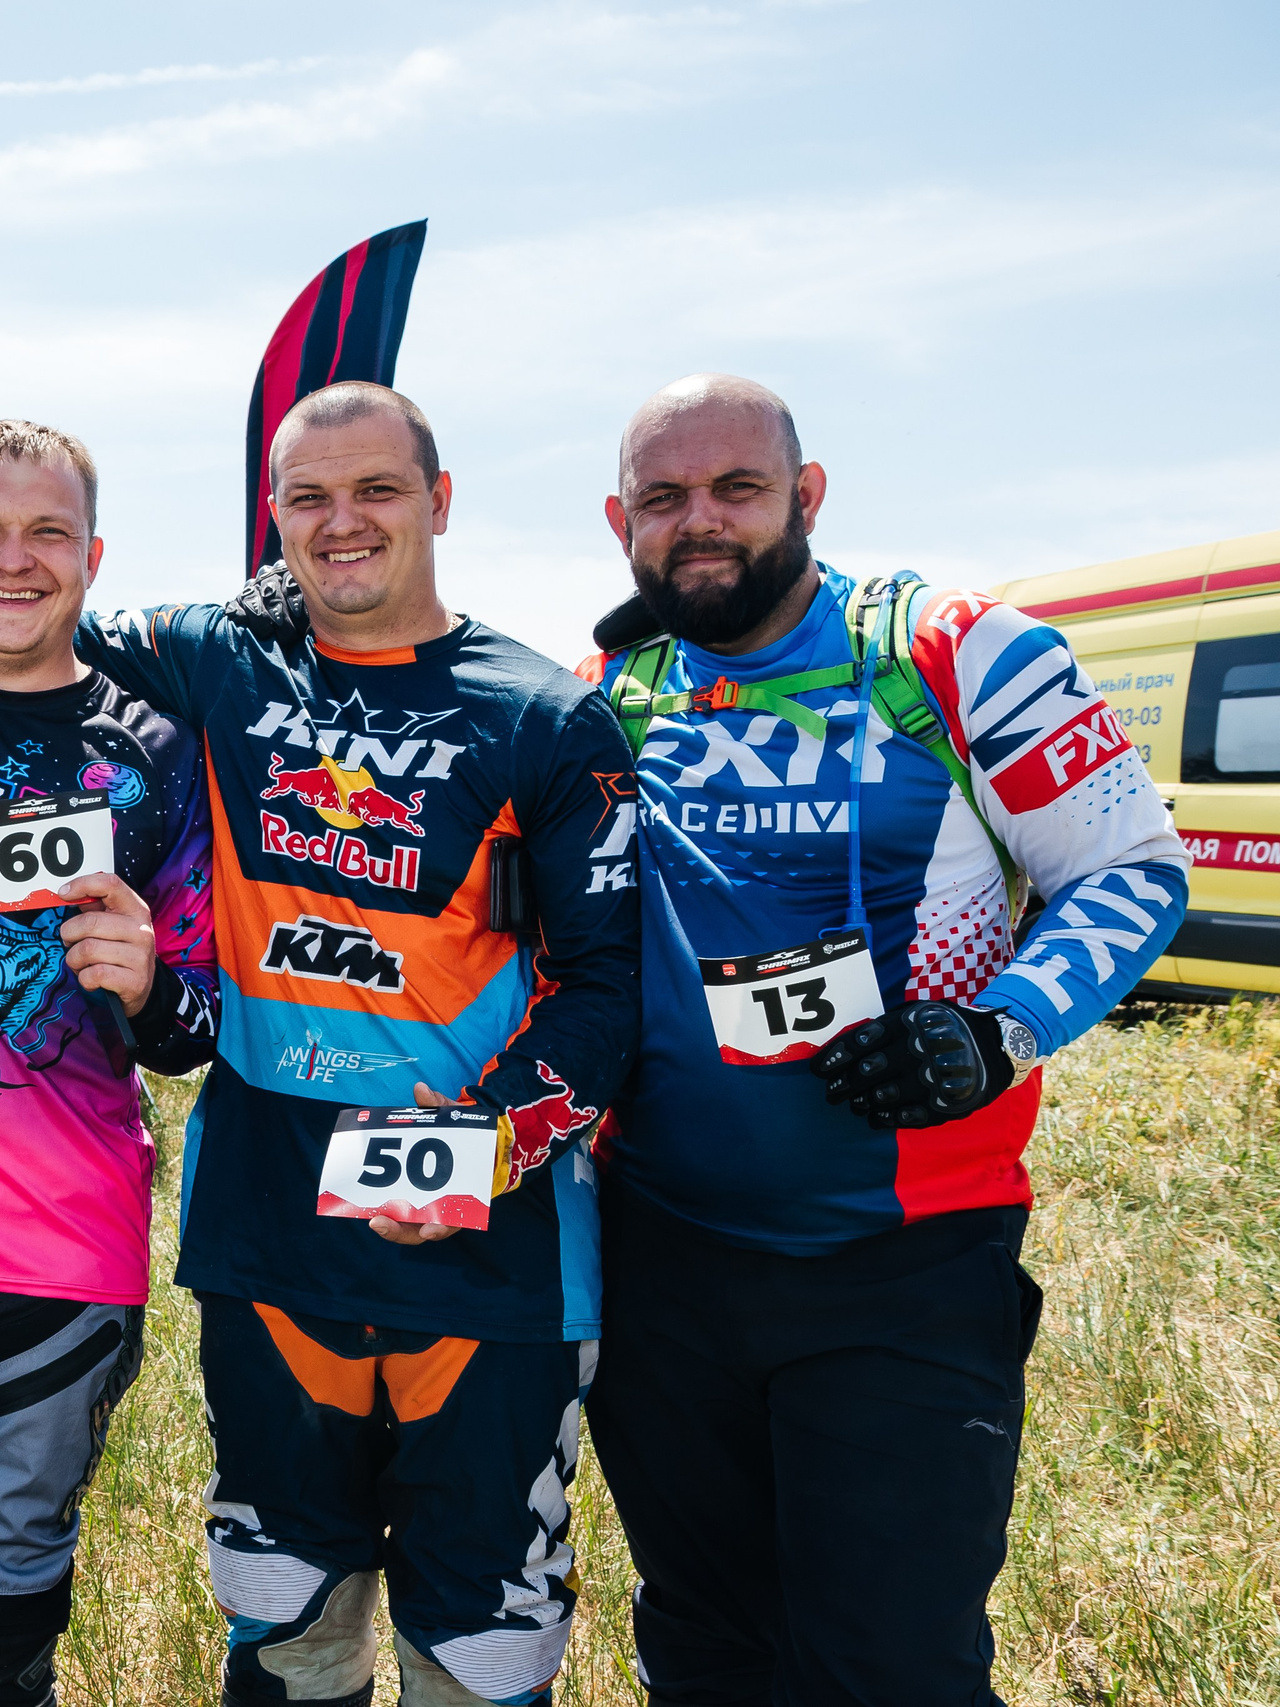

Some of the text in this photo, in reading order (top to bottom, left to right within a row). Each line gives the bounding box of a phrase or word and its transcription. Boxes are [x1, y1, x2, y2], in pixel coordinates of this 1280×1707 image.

[1095, 672, 1175, 693] ный врач
[245, 701, 467, 780] KINI
[260, 809, 421, 892] Red Bull
[259, 914, 405, 994] KTM
[1001, 867, 1173, 1015] FXR
[750, 976, 836, 1036] 13
[288, 1045, 361, 1069] WINGS
[295, 1063, 337, 1084] LIFE
[357, 1137, 454, 1191] 50
